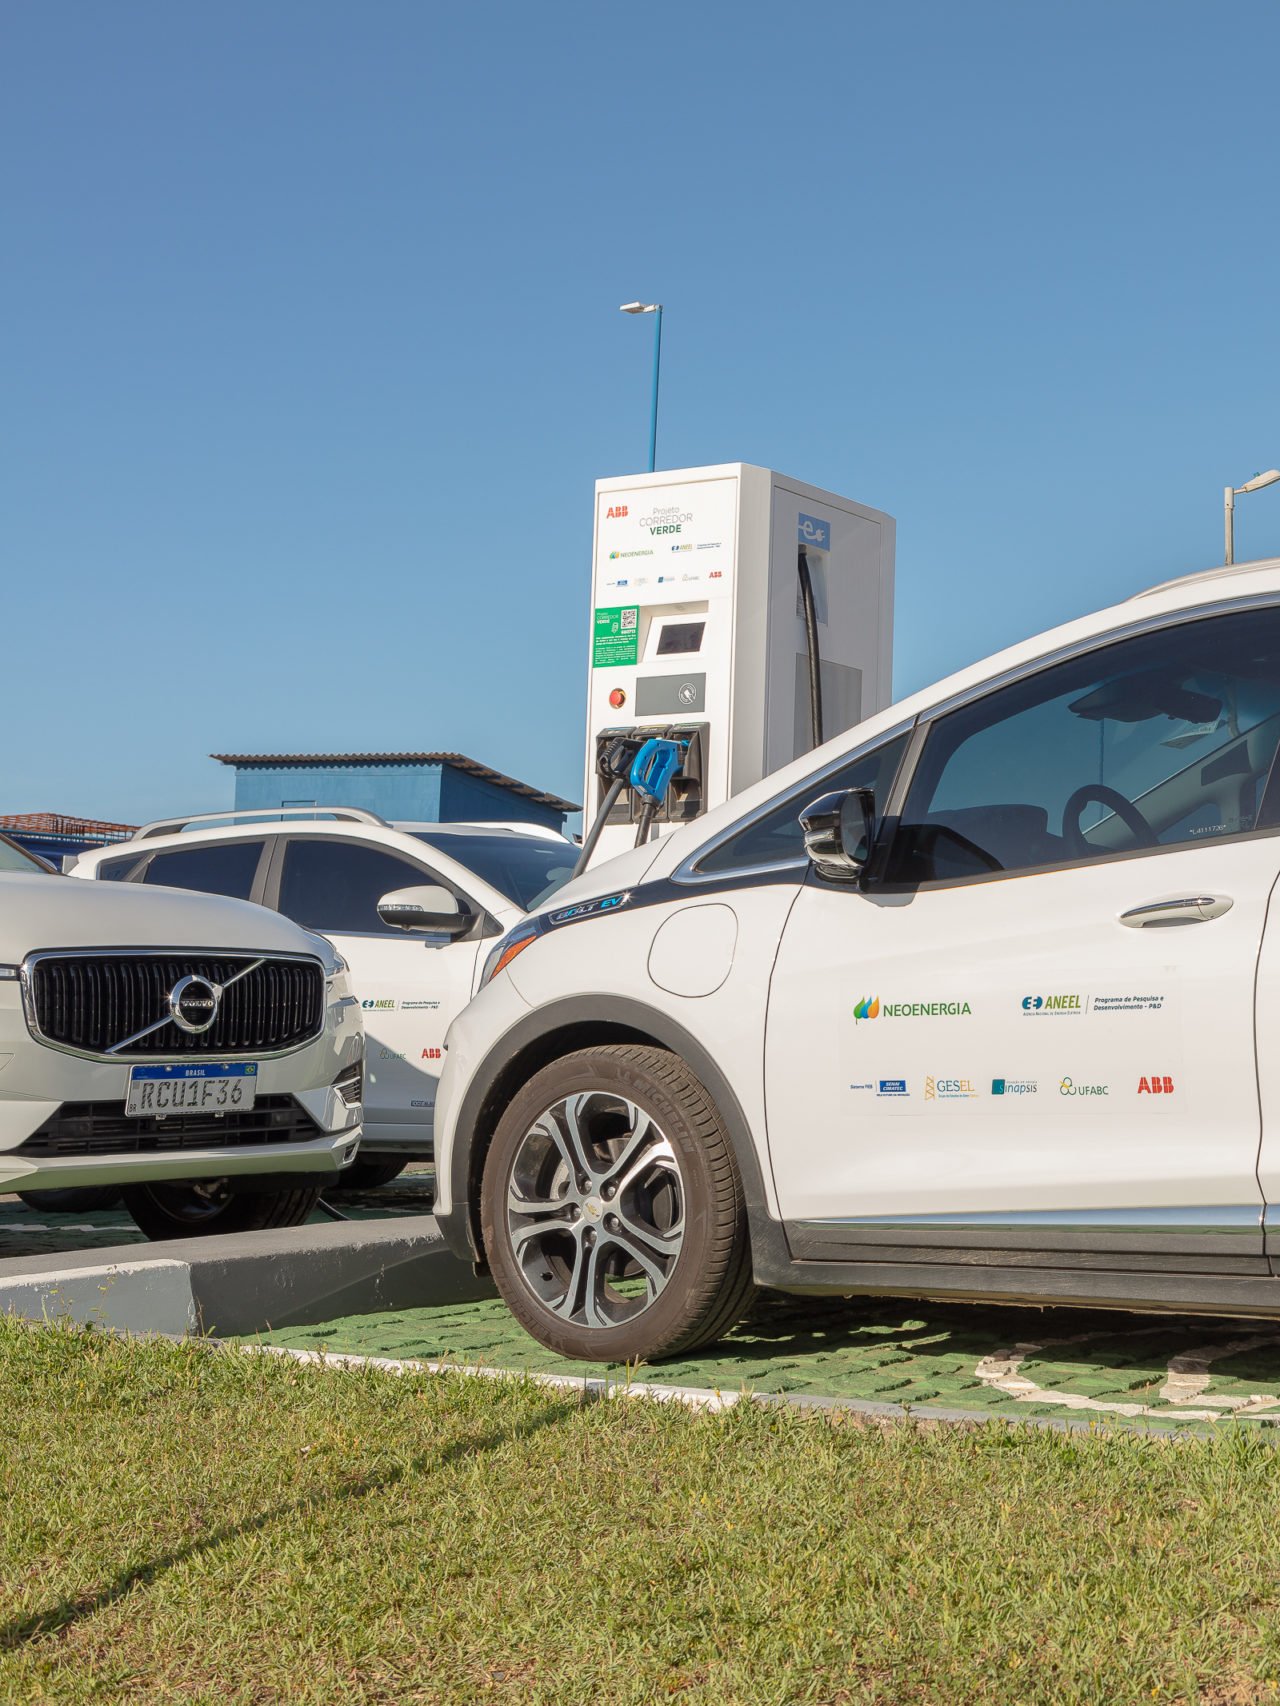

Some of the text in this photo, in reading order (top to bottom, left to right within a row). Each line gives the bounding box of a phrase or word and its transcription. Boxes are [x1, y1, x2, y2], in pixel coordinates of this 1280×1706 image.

[606, 505, 629, 519] ABB
[652, 506, 680, 515] Projeto
[639, 512, 694, 528] CORREDOR
[650, 524, 682, 536] VERDE
[620, 549, 654, 558] NEOENERGIA
[708, 571, 722, 579] ABB
[556, 895, 623, 920] BOLT EV
[374, 1000, 395, 1008] ANEEL
[1044, 994, 1081, 1010] ANEEL
[1132, 995, 1159, 1003] Pesquisa
[883, 1002, 972, 1018] NEOENERGIA
[422, 1048, 441, 1059] ABB
[936, 1080, 975, 1092] GESEL
[1078, 1086, 1109, 1096] UFABC
[1137, 1076, 1174, 1094] ABB
[140, 1079, 242, 1110] RCU1F36
[129, 1104, 137, 1112] BR
[632, 1079, 696, 1153] MICHELIN
